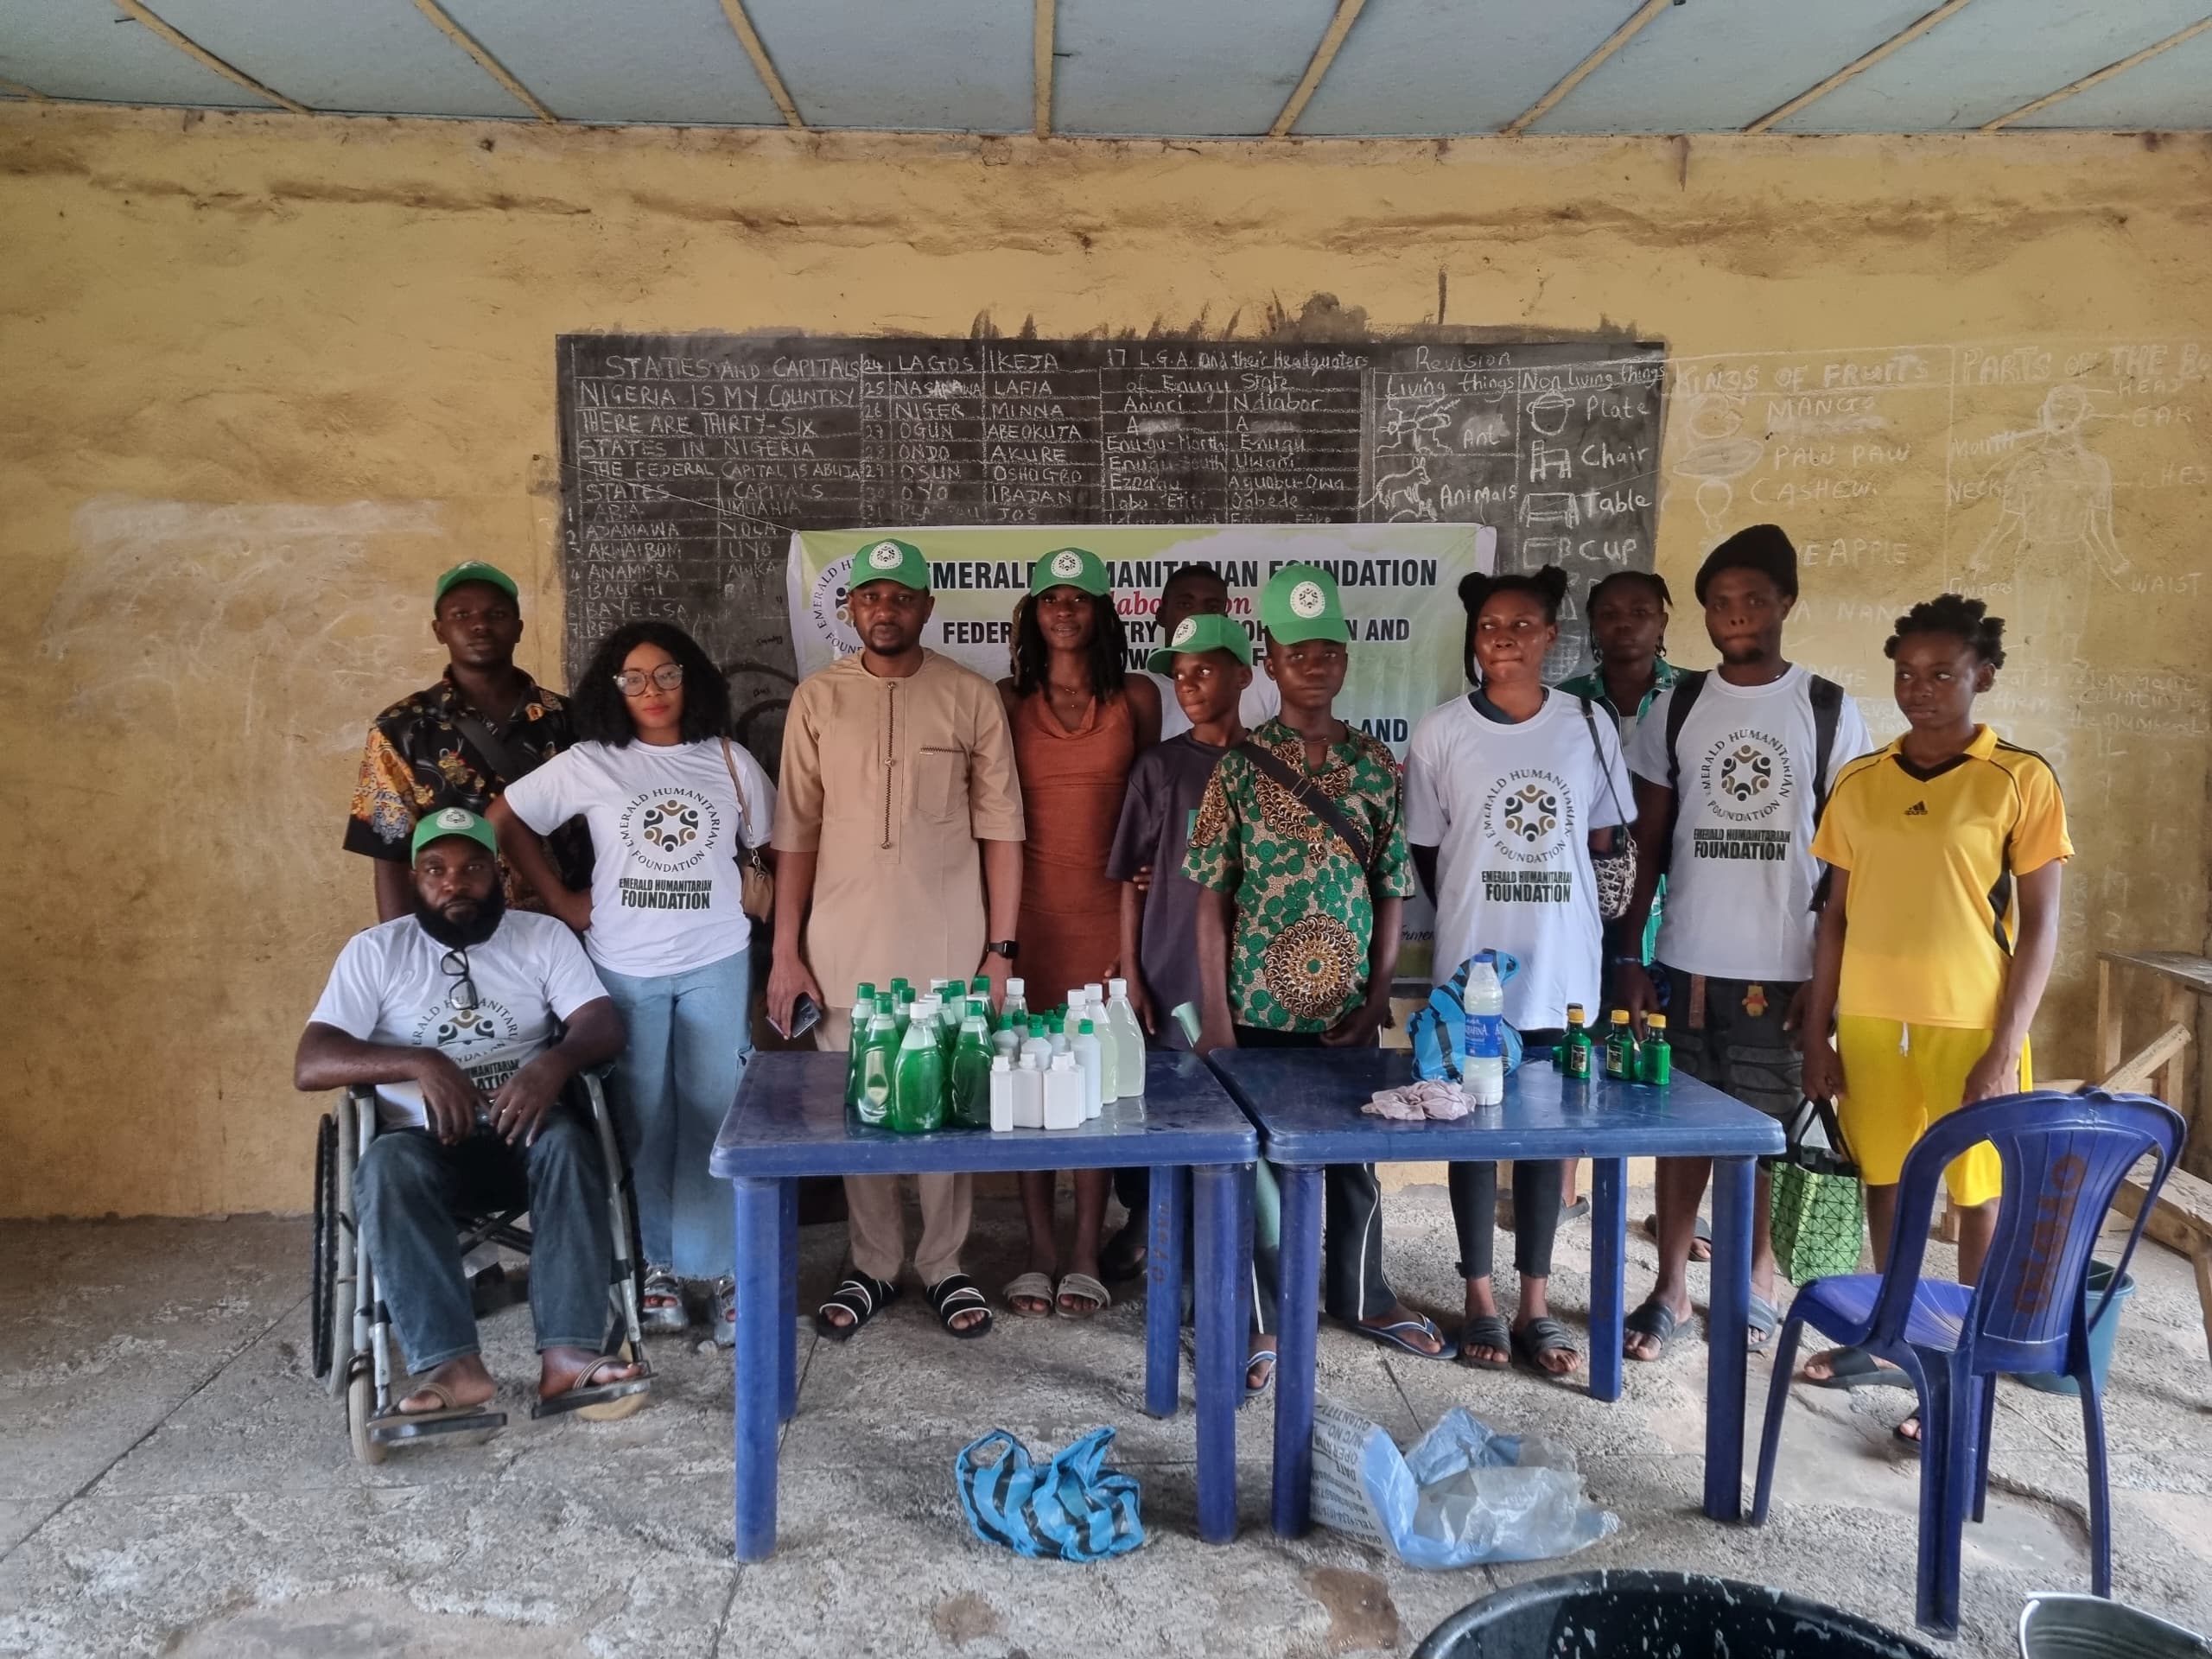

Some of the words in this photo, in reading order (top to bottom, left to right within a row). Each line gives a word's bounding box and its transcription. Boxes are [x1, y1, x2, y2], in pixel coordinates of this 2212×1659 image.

[606, 355, 709, 378] STATES
[721, 363, 760, 380] AND
[773, 357, 860, 378] CAPITALS
[899, 355, 974, 372] LAGOS
[989, 350, 1058, 372] IKEJA
[1108, 348, 1125, 366] 17
[1232, 350, 1268, 367] their
[1416, 346, 1510, 371] Revision
[1963, 347, 2051, 385] PARTS
[995, 380, 1052, 395] LAFIA
[1241, 372, 1287, 393] State
[1387, 375, 1446, 398] Living
[1459, 372, 1515, 401] things
[1522, 372, 1560, 390] Non
[1776, 365, 1808, 391] OF
[581, 380, 676, 407] NIGERIA
[692, 385, 713, 406] IS
[725, 385, 758, 409] MY
[770, 385, 854, 407] COUNTRY
[895, 403, 964, 419] NIGER
[992, 402, 1064, 418] MINNA
[1586, 395, 1651, 421] Plate
[582, 410, 643, 433] THERE
[651, 414, 691, 433] ARE
[899, 423, 952, 439] OGUN
[988, 423, 1082, 440] ABEOKUTA
[1464, 424, 1501, 449] Ant
[580, 440, 667, 457] STATES
[683, 441, 705, 456] IN
[724, 440, 815, 457] NIGERIA
[899, 445, 950, 461] ONDO
[992, 444, 1066, 462] AKURE
[1581, 442, 1649, 467] Chair
[588, 461, 623, 480] THE
[636, 463, 715, 477] FEDERAL
[721, 461, 782, 477] CAPITAL
[793, 463, 808, 477] IS
[812, 463, 861, 479] ABUJA
[900, 464, 961, 481] OSUN
[587, 483, 671, 502] STATES
[902, 484, 949, 501] OYO
[993, 486, 1071, 505] IBADAN
[1440, 484, 1517, 511] Animals
[1581, 487, 1652, 518] Table
[998, 506, 1037, 520] JOS
[926, 562, 1037, 588] MERAL
[943, 621, 1012, 644] FEDER
[1365, 619, 1410, 641] AND
[1362, 718, 1408, 742] AND
[1701, 740, 1726, 797] MERALD
[620, 794, 649, 848] EMERALD
[652, 788, 720, 849] HUMANITARIAN
[632, 850, 705, 873] FOUNDATION
[1494, 840, 1566, 863] FOUNDATION
[1694, 841, 1786, 861] FOUNDATION
[619, 878, 652, 891] EMERALD
[655, 880, 712, 892] HUMANITARIAN
[1481, 871, 1516, 883] EMERALD
[621, 890, 710, 909] FOUNDATION
[1485, 883, 1571, 903] FOUNDATION
[412, 1006, 440, 1046] ERALD
